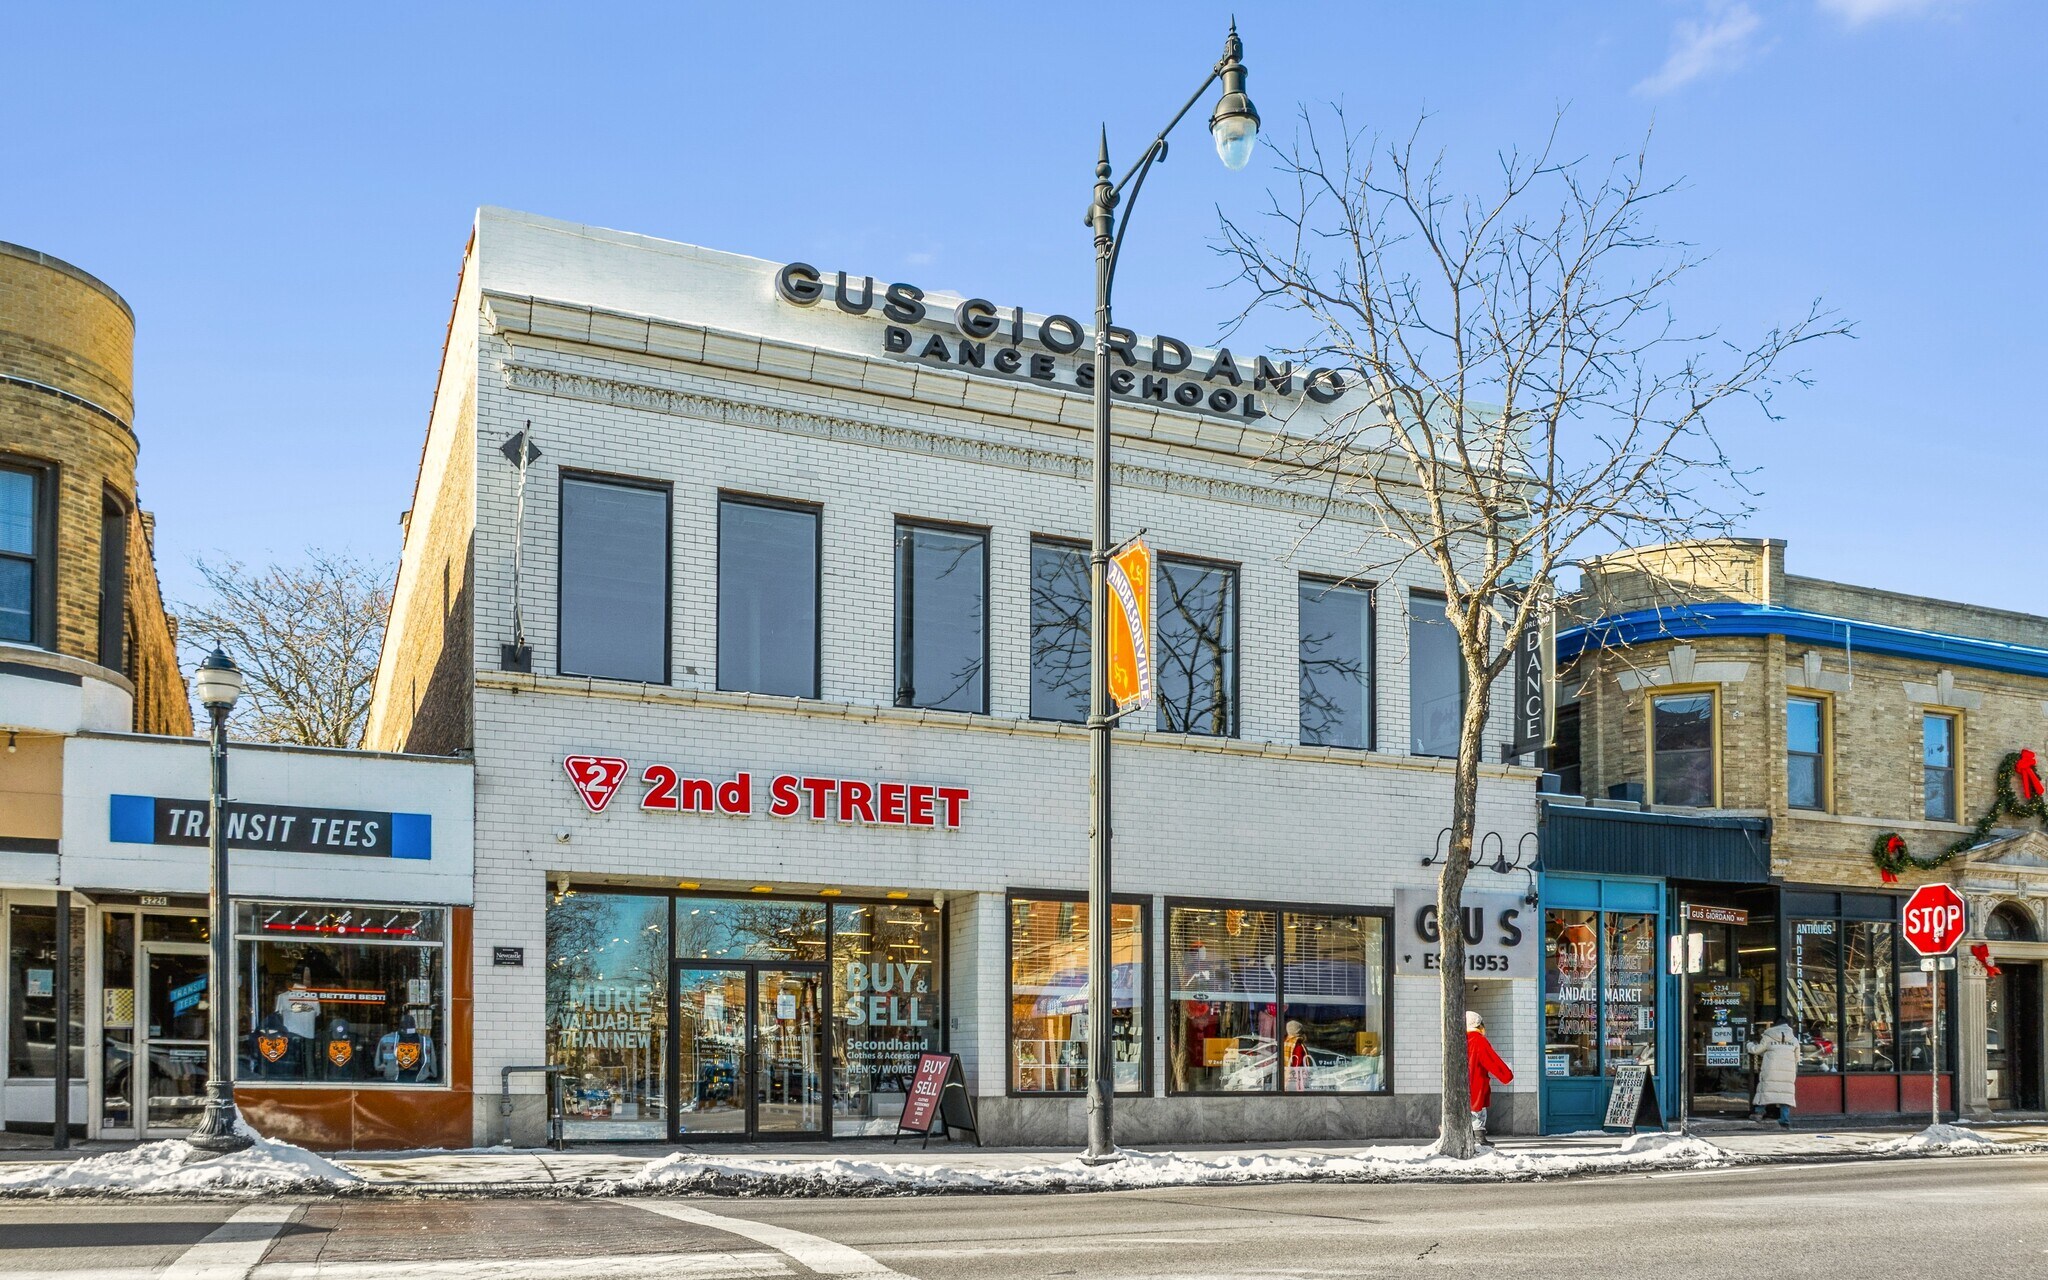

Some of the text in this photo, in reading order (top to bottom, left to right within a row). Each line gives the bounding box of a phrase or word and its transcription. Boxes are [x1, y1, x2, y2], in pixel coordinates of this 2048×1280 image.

[776, 262, 1346, 404] GUS GIORDANO
[884, 325, 1056, 382] DANCE
[1075, 363, 1266, 421] SCHOOL
[1109, 564, 1150, 701] ANDERSONVILLE
[1525, 630, 1543, 740] DANCE
[586, 765, 608, 793] 2
[640, 764, 971, 829] 2nd STREET
[311, 817, 380, 848] TEES
[1416, 904, 1522, 947] GUS
[1691, 910, 1704, 919] GUS
[1706, 912, 1735, 922] GIORDANO
[1908, 904, 1961, 934] STOP
[1796, 924, 1833, 935] ANTIQUES
[1468, 954, 1509, 971] 1953
[846, 962, 928, 993] BUY &
[173, 979, 206, 998] TRANSIT
[320, 992, 357, 1000] BETTER
[1604, 988, 1643, 1002] MARKET
[106, 989, 115, 1023] FIKA
[180, 995, 200, 1008] TEES
[570, 984, 652, 1013] MORE
[846, 995, 928, 1027] SELL
[560, 1012, 652, 1031] VALUABLE
[559, 1030, 651, 1049] THAN NEW
[846, 1038, 929, 1051] Secondhand
[846, 1051, 921, 1060] Clothes & Accessori
[1707, 1057, 1739, 1065] CHICAGO
[922, 1059, 947, 1075] BUY
[914, 1081, 938, 1096] SELL
[1615, 1093, 1625, 1102] THE
[1610, 1109, 1623, 1117] BACK
[1612, 1101, 1626, 1110] TAKE
